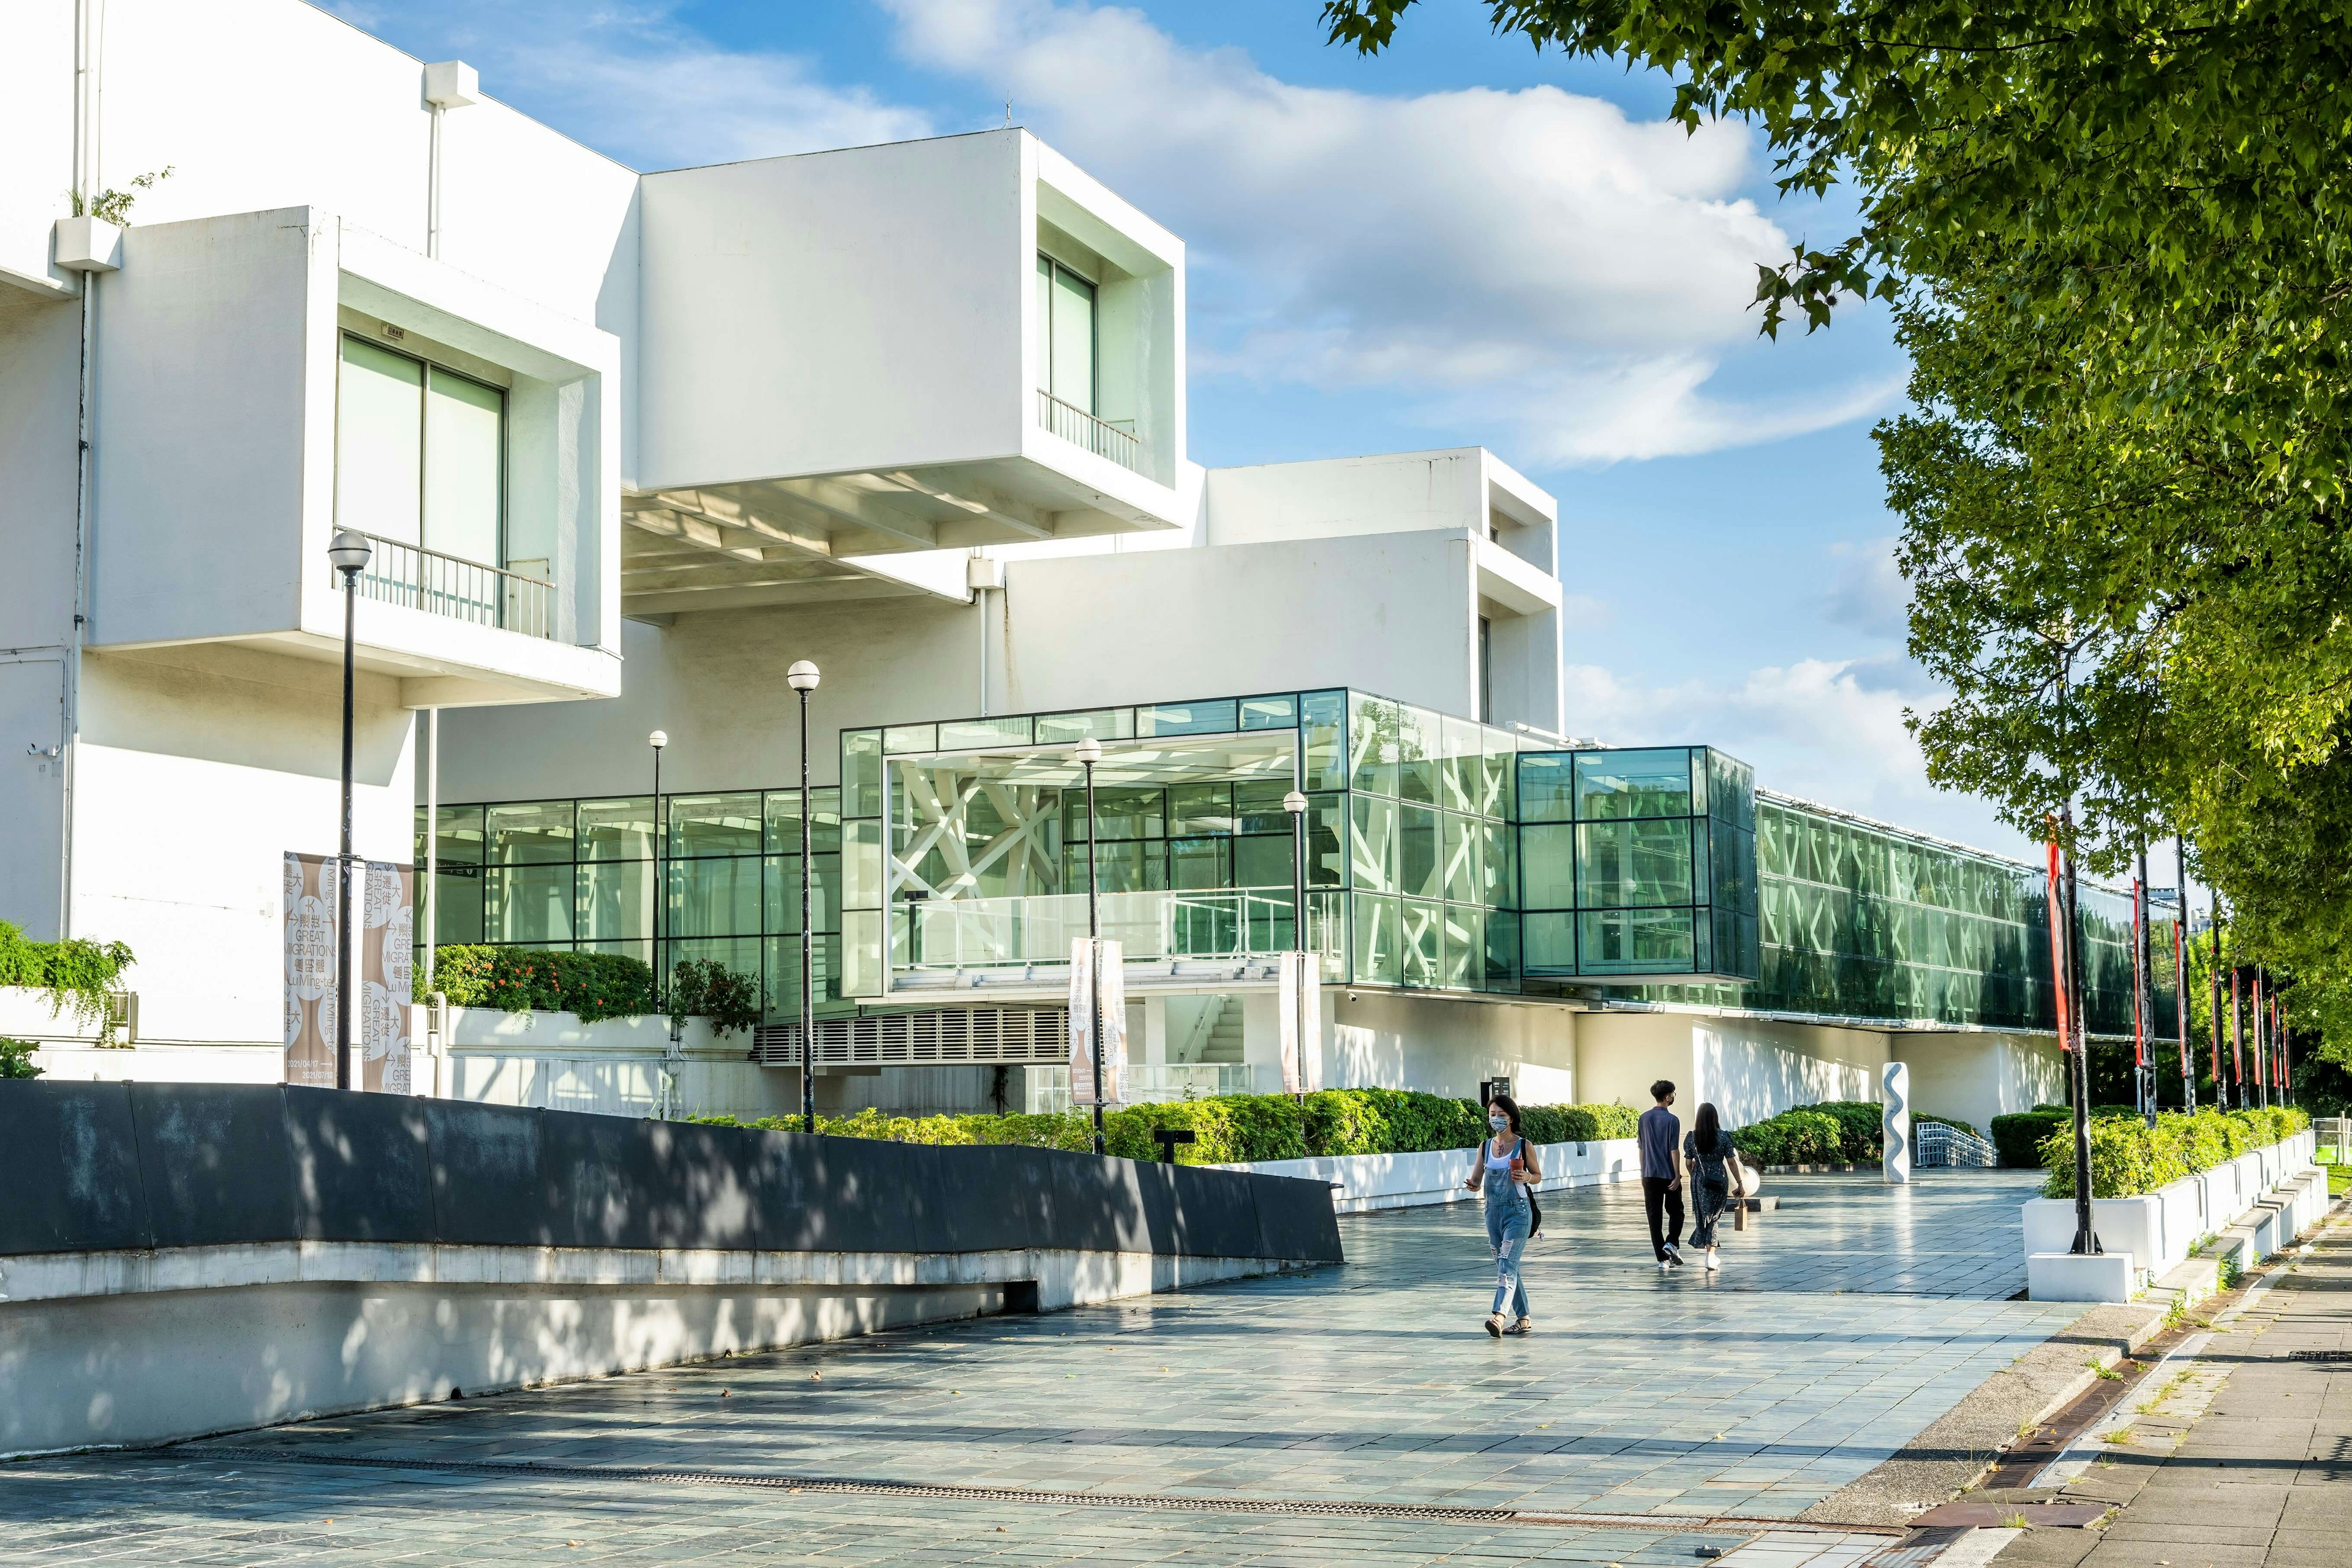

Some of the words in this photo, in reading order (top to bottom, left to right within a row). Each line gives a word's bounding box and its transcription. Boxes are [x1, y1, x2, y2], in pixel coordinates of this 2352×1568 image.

[293, 873, 302, 888] 大
[325, 869, 336, 917] Ming-te
[364, 862, 374, 929] GRATIONS
[374, 867, 382, 914] GREAT
[382, 875, 392, 905] 遷徙
[392, 884, 401, 898] 大
[306, 899, 315, 913] 大
[300, 913, 320, 929] 遷徙
[296, 929, 325, 943] GREAT
[394, 938, 412, 951] GRE
[383, 951, 412, 963] MIGRAT
[295, 958, 325, 973] 盧明德
[393, 965, 412, 979] 盧明
[288, 974, 298, 986] Lu
[300, 974, 333, 990] Ming-te
[388, 981, 396, 992] Lu
[291, 1010, 300, 1024] 大
[380, 1007, 390, 1036] 遷徙
[390, 1016, 399, 1029] 大
[325, 1004, 335, 1052] Ming-te
[287, 1059, 318, 1068] 2021/04/17
[302, 1071, 333, 1080] 2021/07/18
[393, 1069, 410, 1082] GRE
[382, 1083, 410, 1095] MIGRAT
